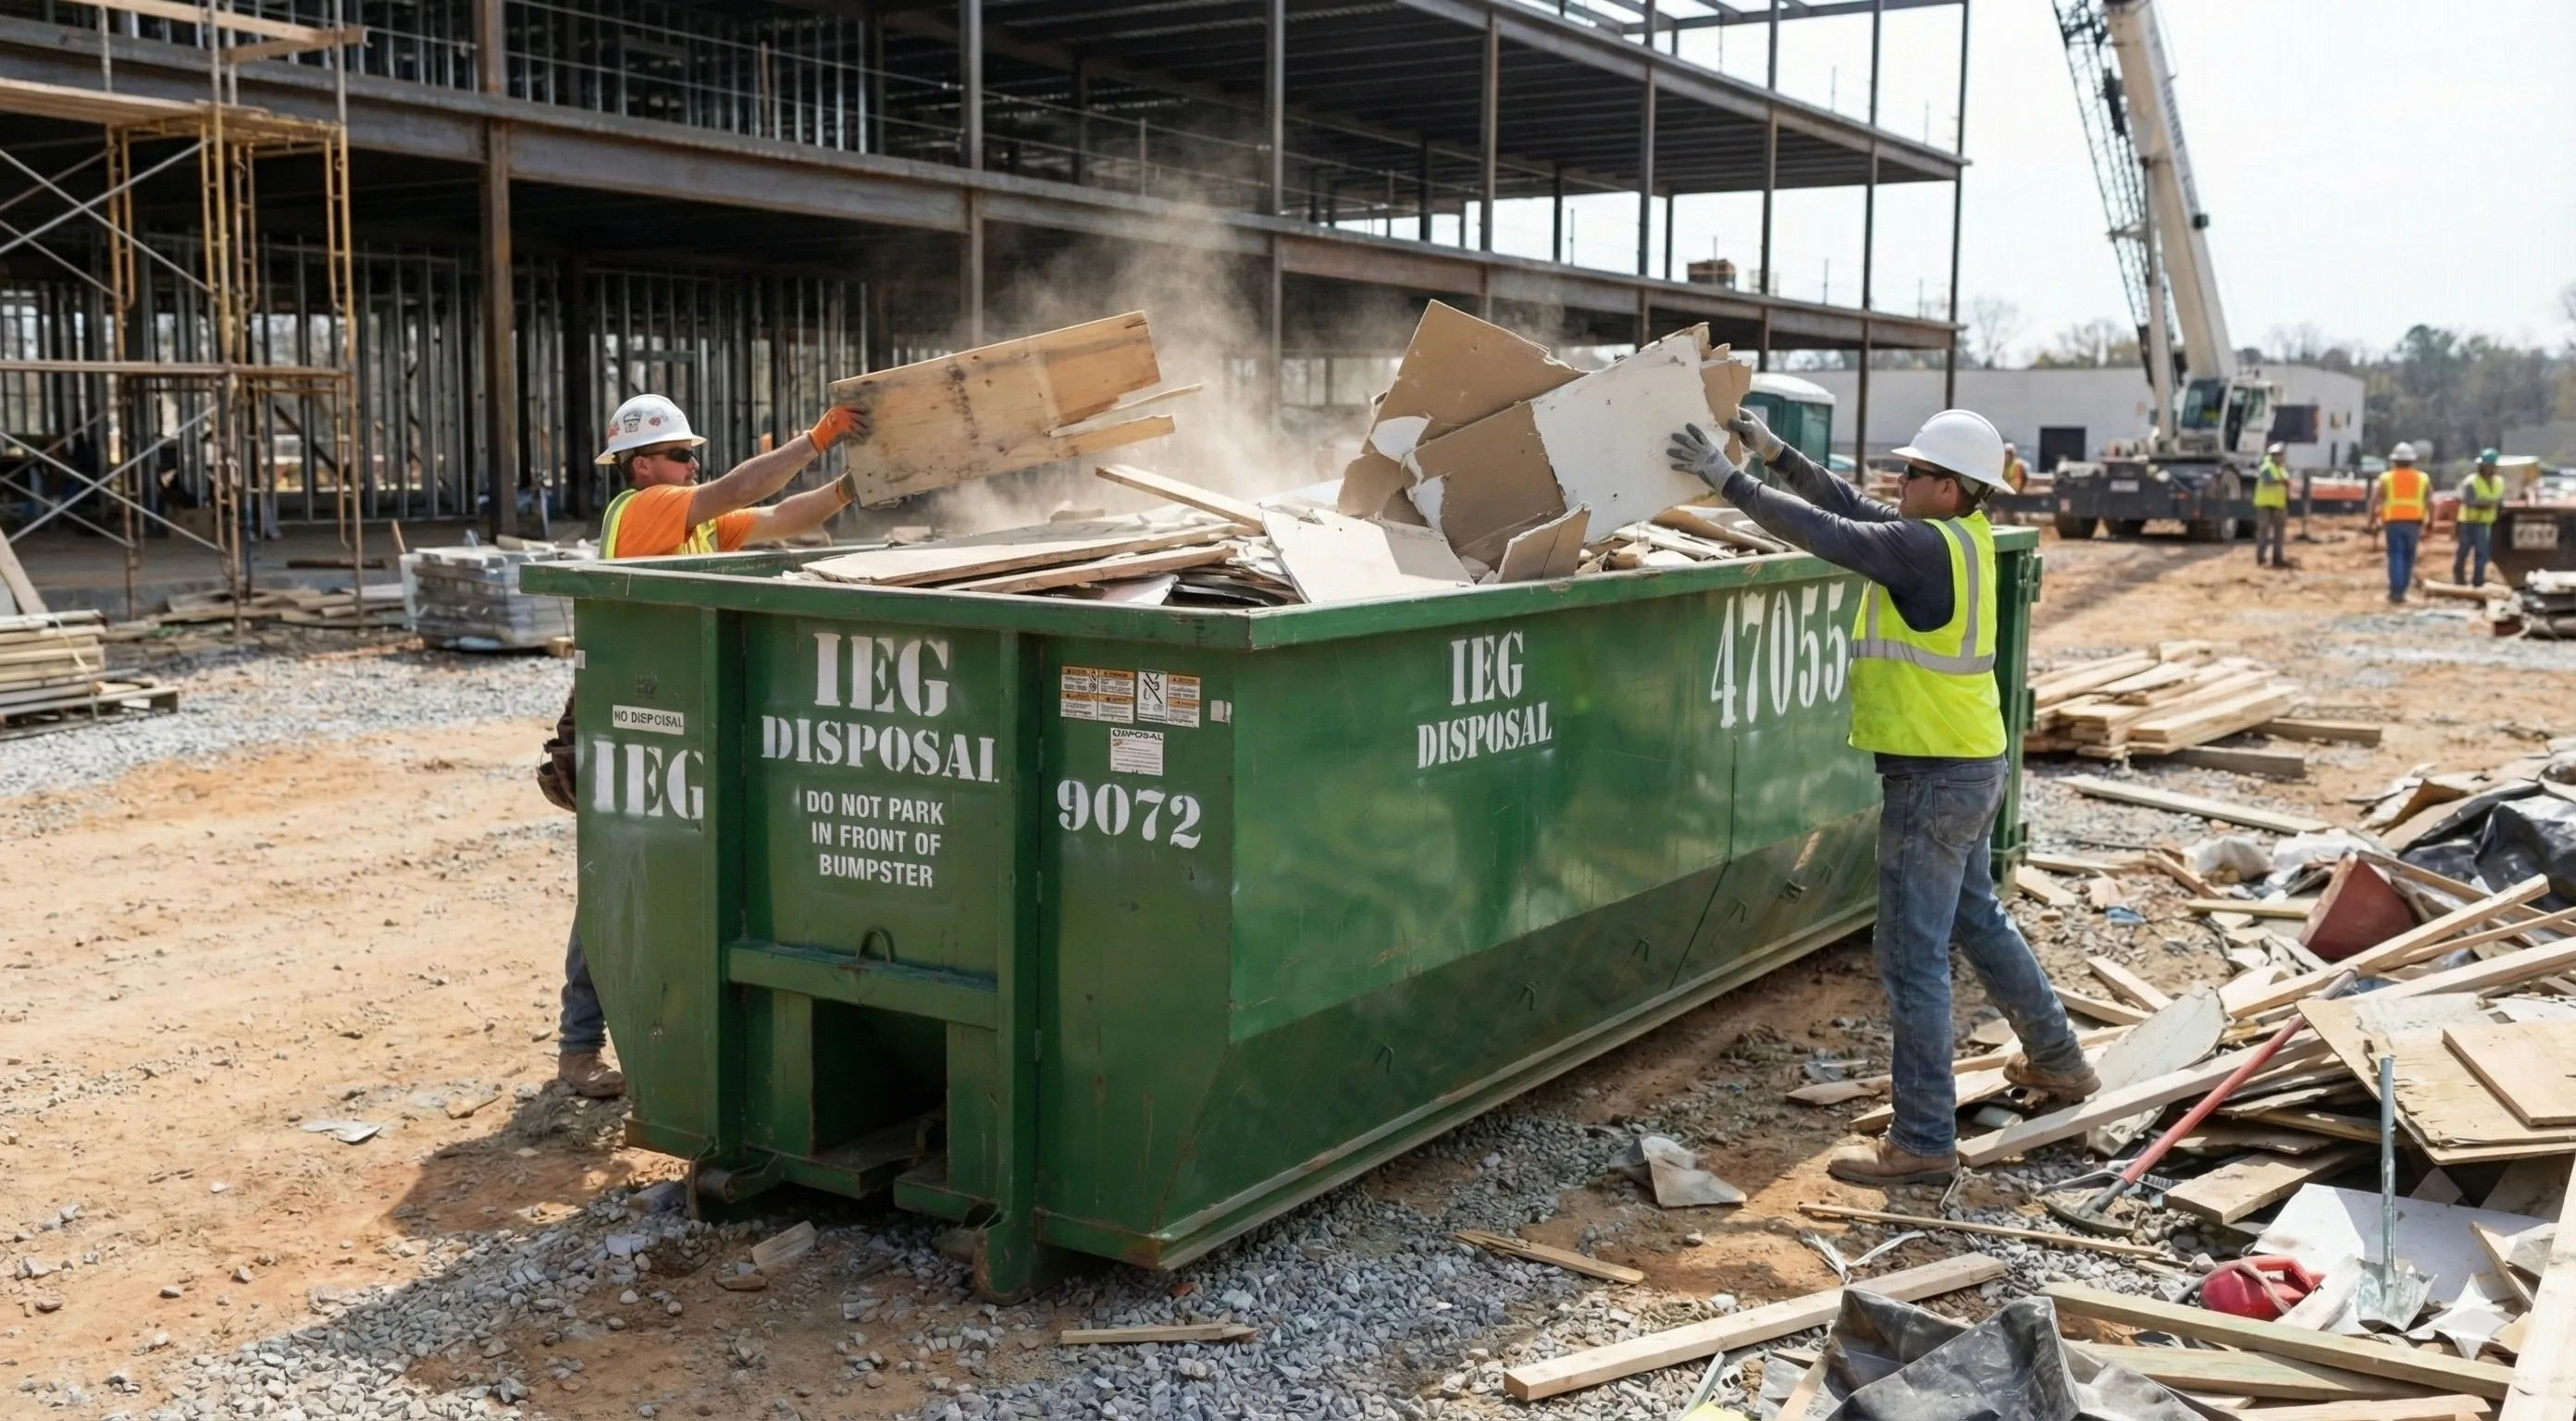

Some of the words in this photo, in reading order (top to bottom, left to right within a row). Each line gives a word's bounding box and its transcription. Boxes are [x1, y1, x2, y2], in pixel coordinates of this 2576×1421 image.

[813, 632, 949, 717] IEG
[1451, 630, 1524, 707] IEG
[761, 715, 1000, 784] DISPOSAL
[1417, 700, 1554, 769] DISPOSAL
[592, 739, 704, 822] IEG
[806, 791, 835, 814] DO
[841, 794, 884, 819] NOT
[888, 797, 946, 826] PARK
[1056, 779, 1202, 849] 9072
[811, 822, 832, 846] IN
[839, 824, 907, 853] FRONT
[914, 831, 942, 857] OF
[819, 853, 934, 888] BUMPSTER
